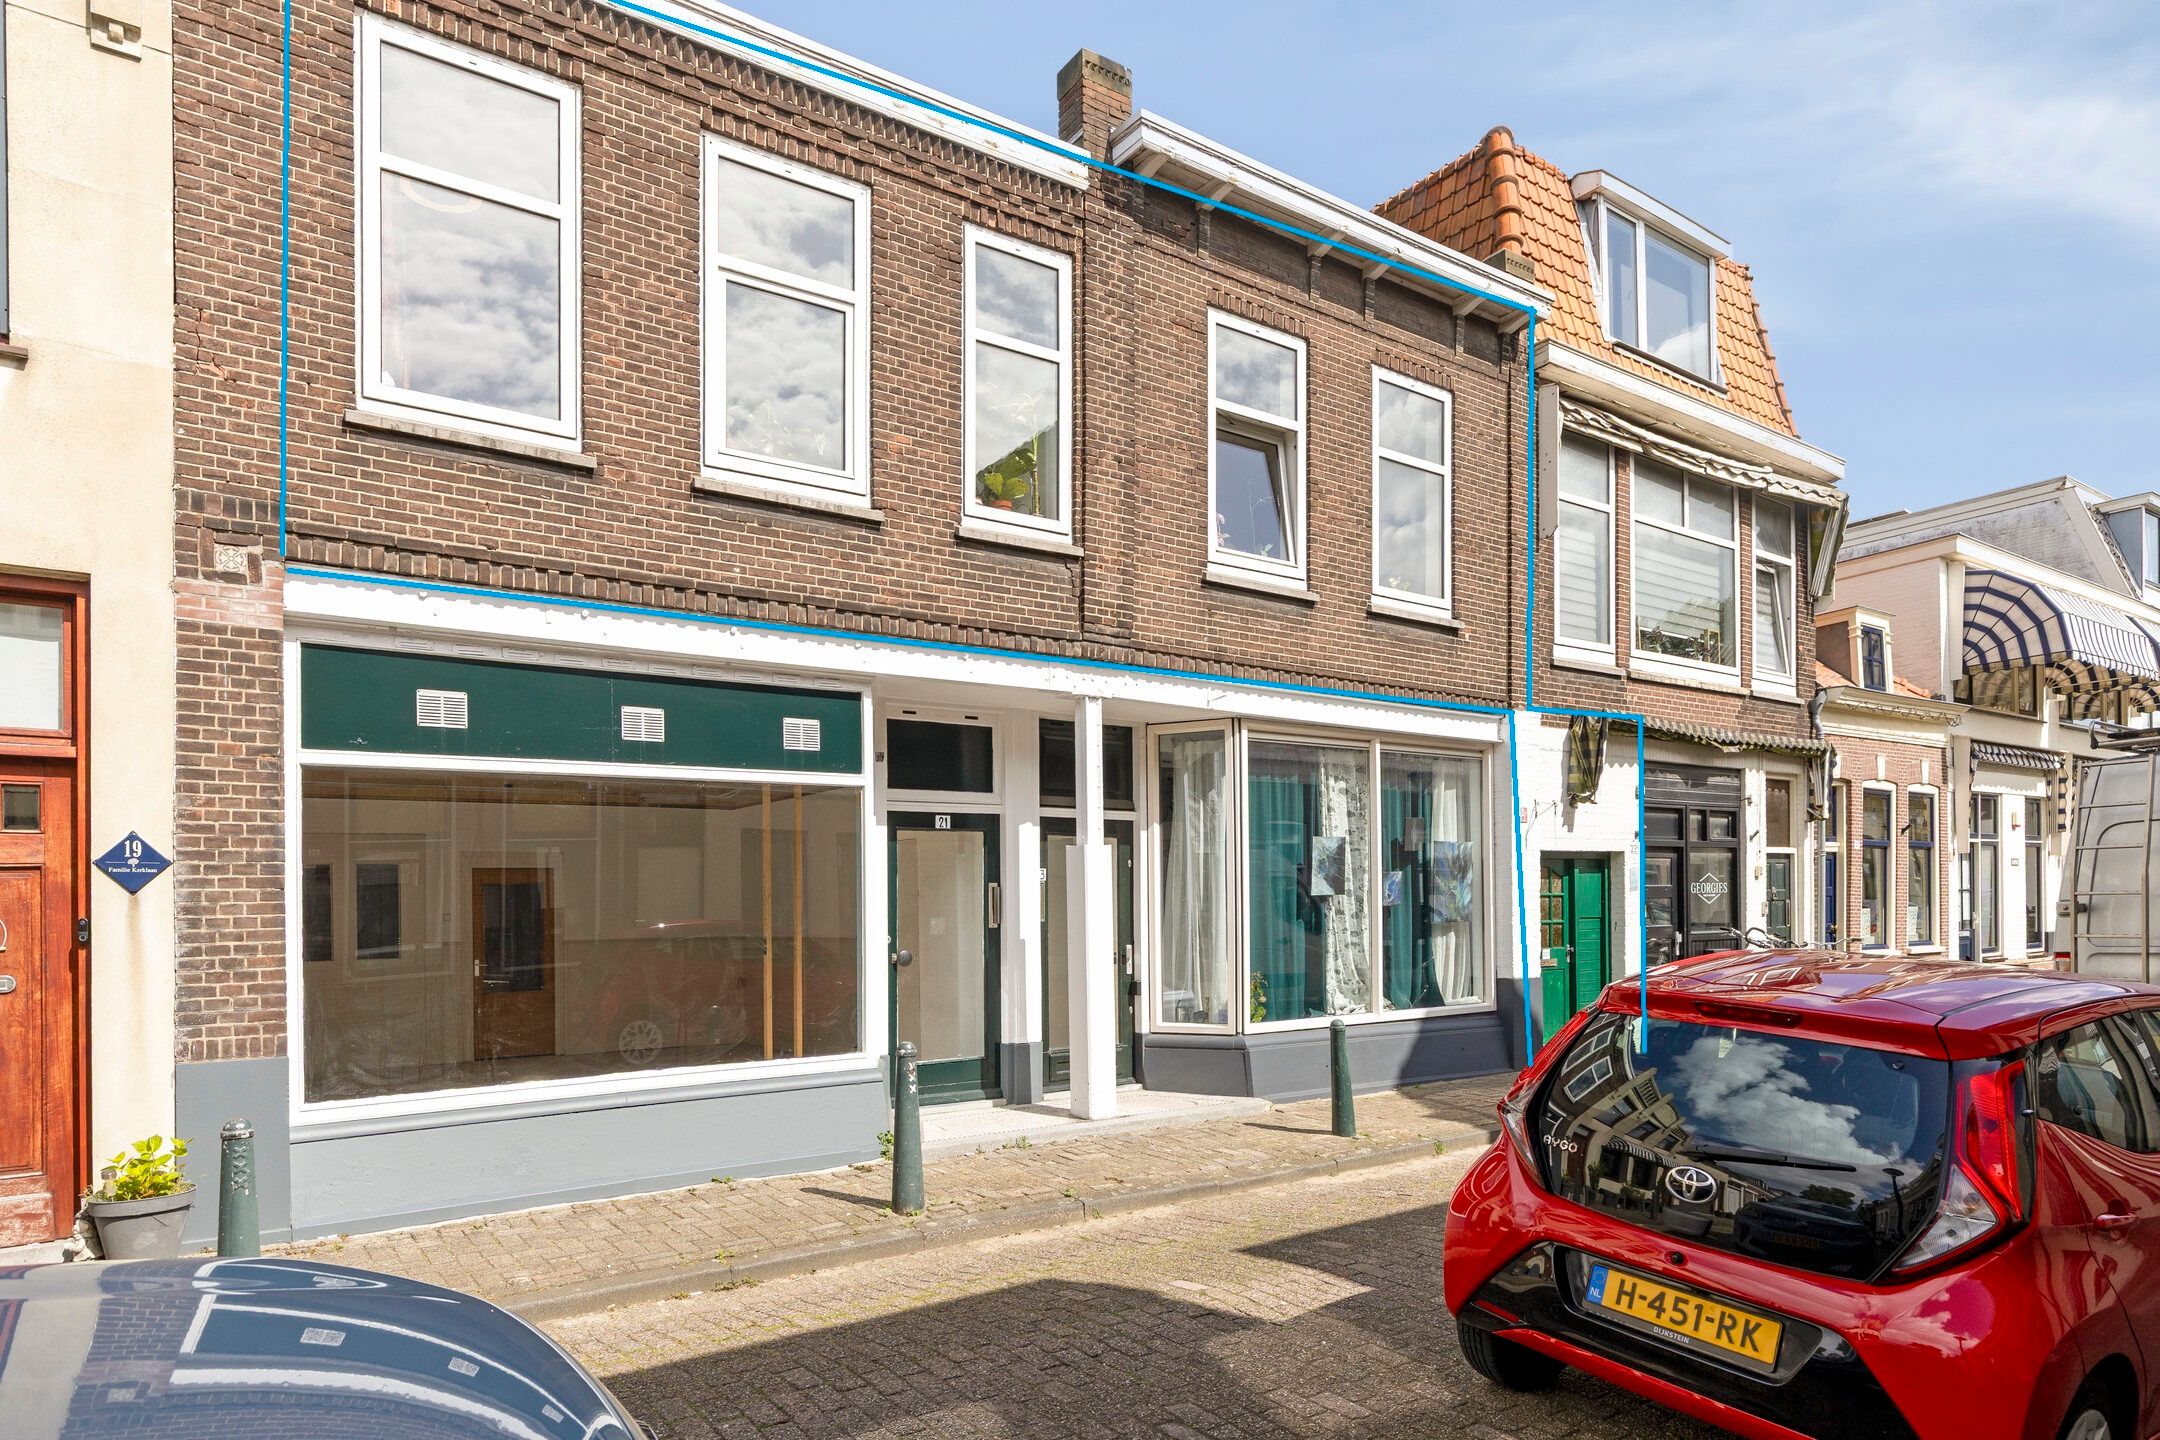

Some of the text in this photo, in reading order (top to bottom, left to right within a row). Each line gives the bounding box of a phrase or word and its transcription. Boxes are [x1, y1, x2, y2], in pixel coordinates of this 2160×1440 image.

[938, 816, 948, 828] 21
[124, 840, 142, 858] 19
[1690, 882, 1728, 894] GEORGIES
[1543, 1134, 1578, 1153] AYGO
[1589, 1286, 1602, 1298] NL
[1615, 1278, 1763, 1353] H-451-RK
[1653, 1326, 1690, 1344] DIJKSTEIN
